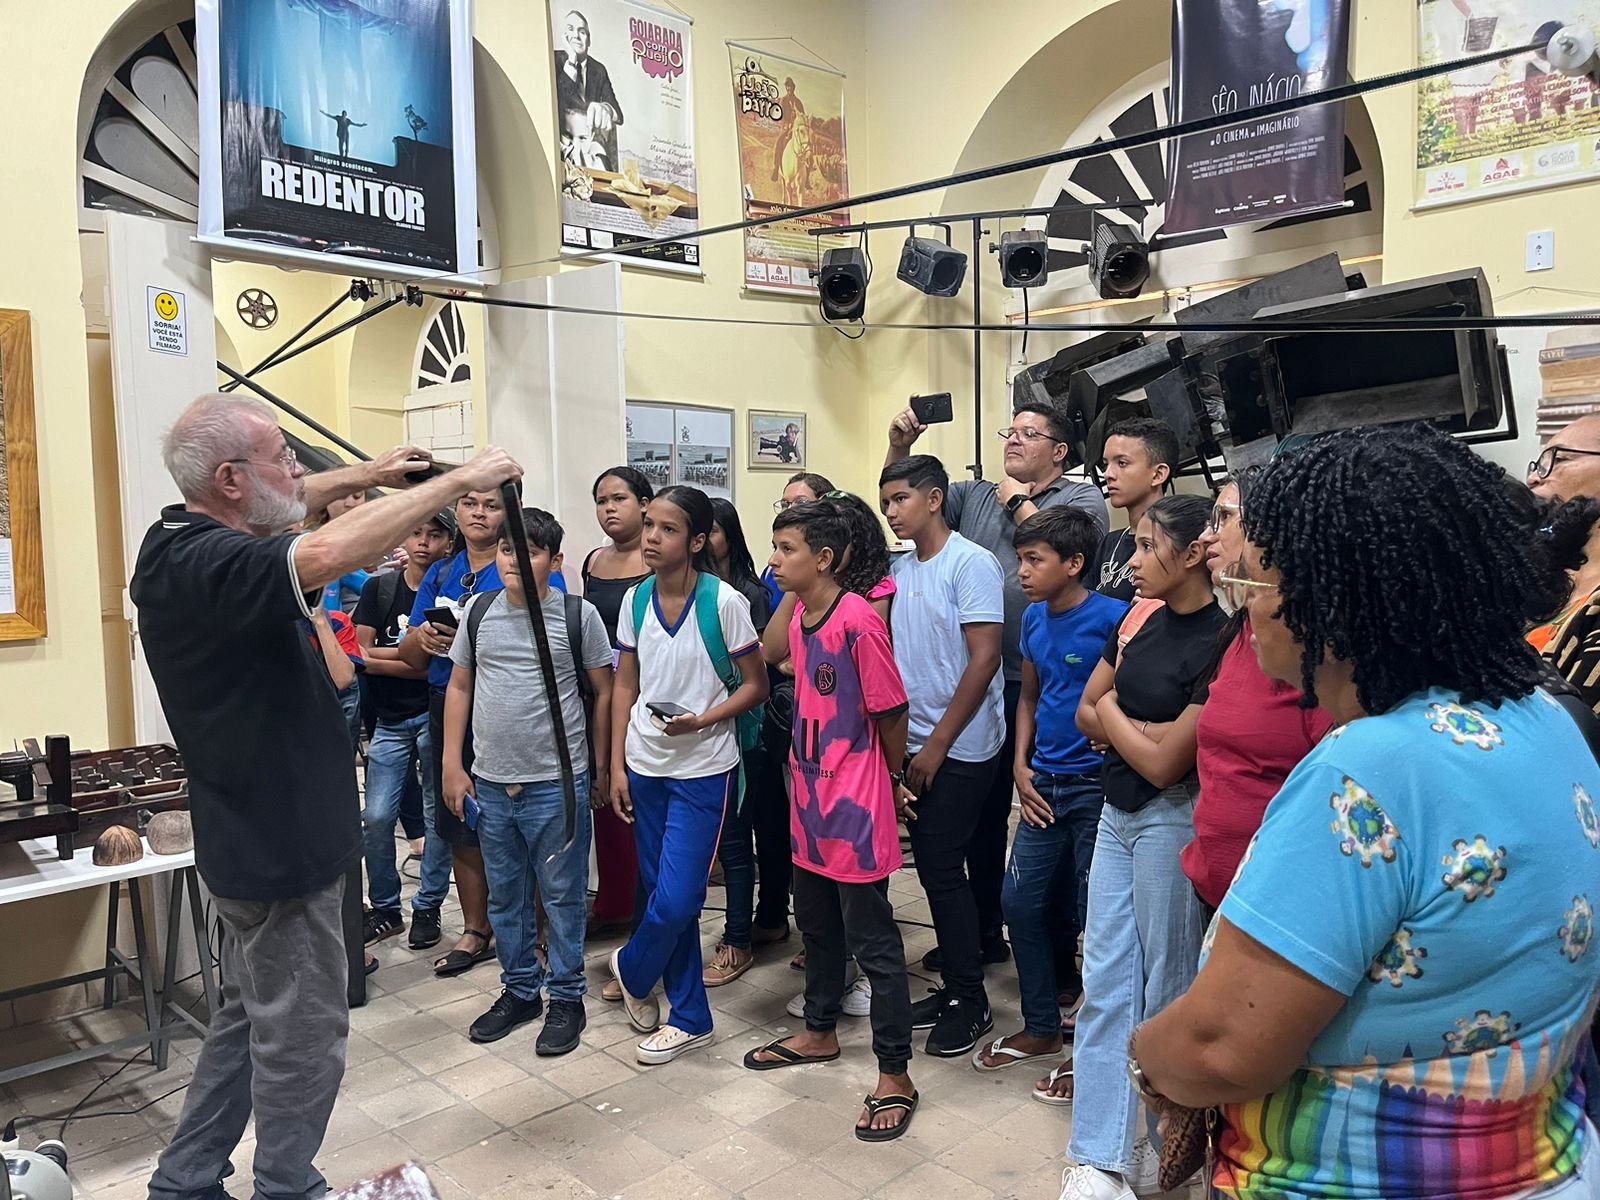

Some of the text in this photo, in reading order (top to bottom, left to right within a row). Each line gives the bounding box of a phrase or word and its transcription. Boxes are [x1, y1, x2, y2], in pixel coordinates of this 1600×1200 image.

[629, 16, 683, 53] GOIABADA
[646, 41, 667, 54] com
[1256, 116, 1300, 135] IMAGINÁRIO
[1215, 128, 1250, 145] O CINEMA
[1483, 169, 1520, 182] AGAE
[260, 159, 426, 226] REDENTOR
[154, 321, 181, 331] SORRIA!
[156, 342, 181, 350] FILMADO
